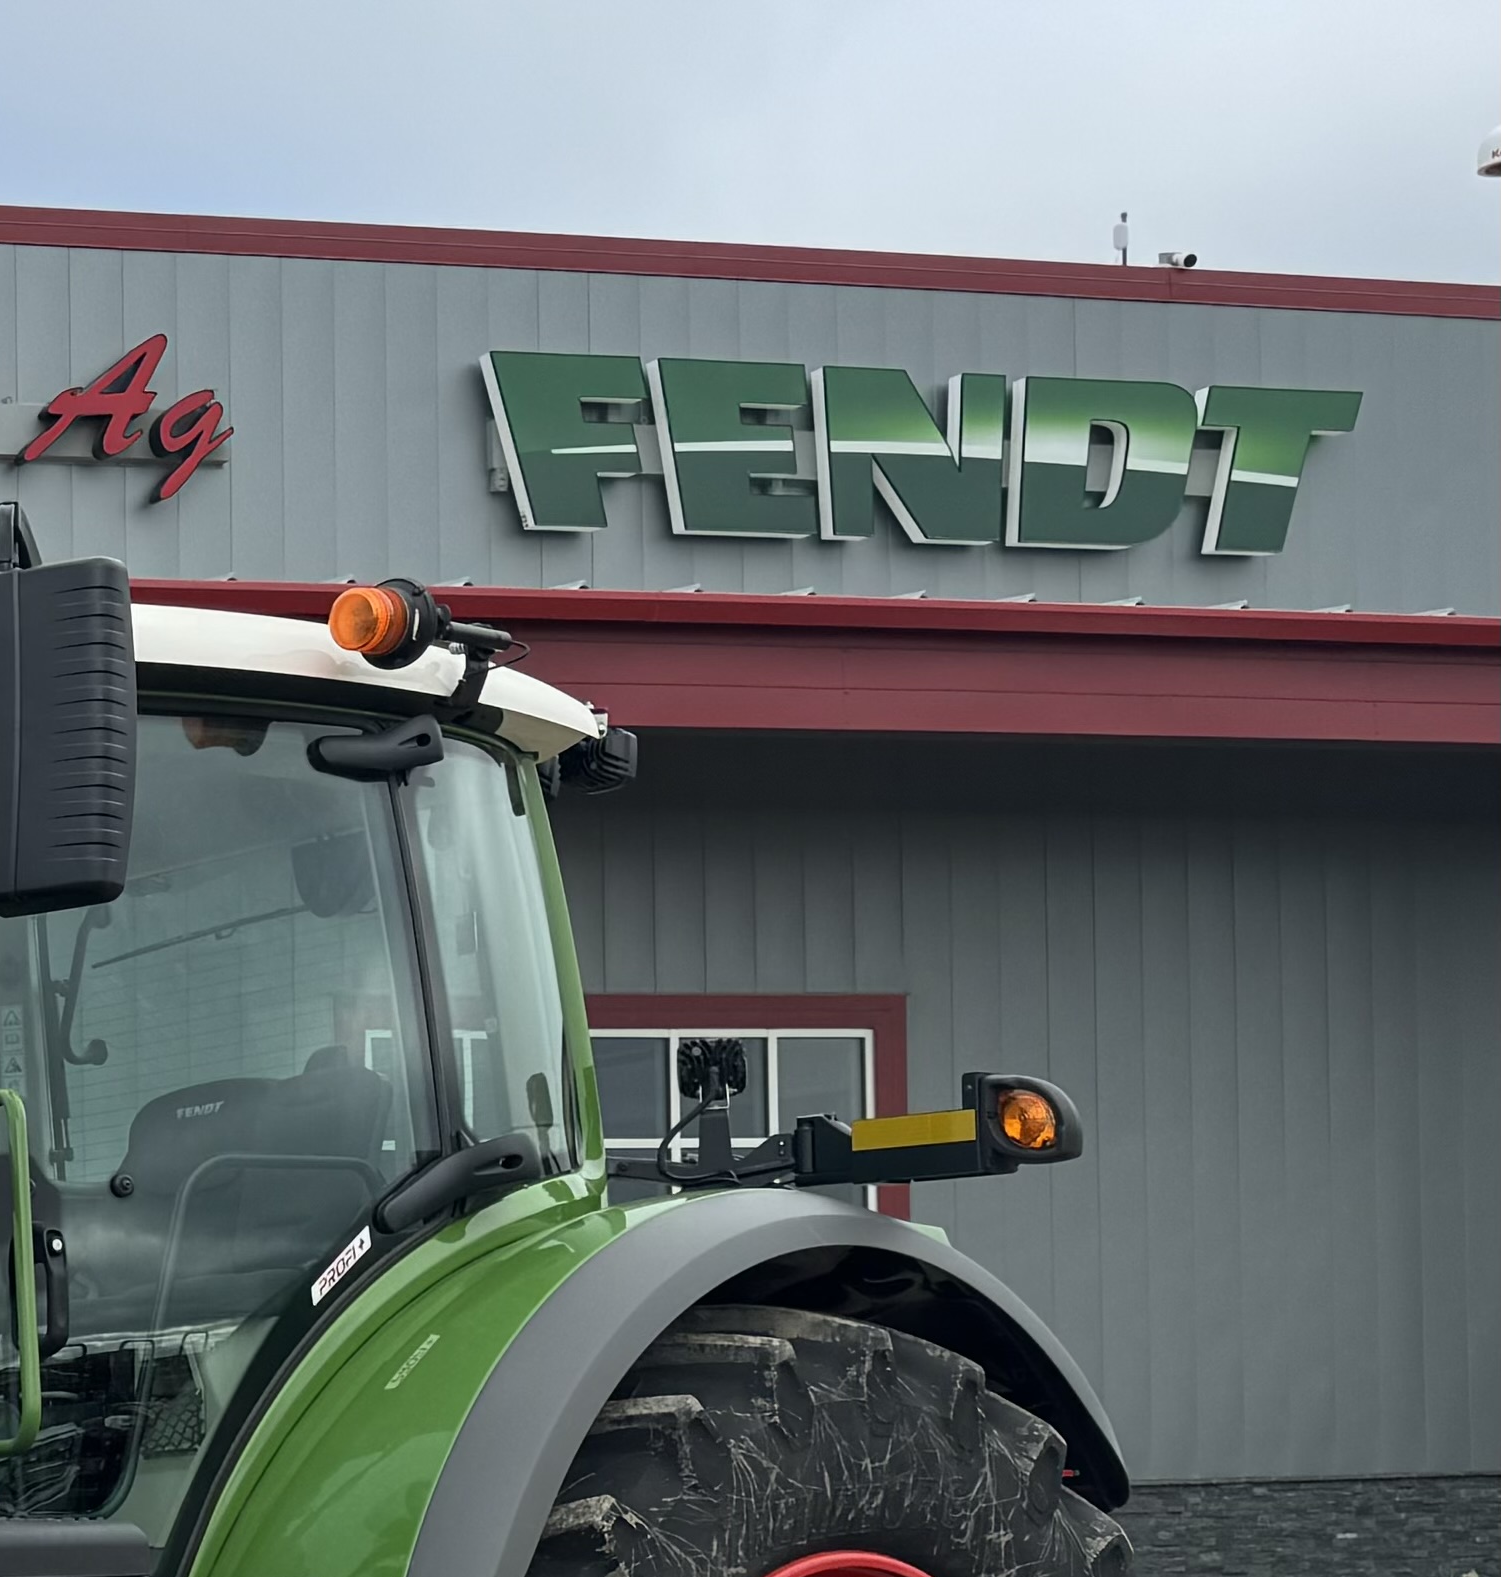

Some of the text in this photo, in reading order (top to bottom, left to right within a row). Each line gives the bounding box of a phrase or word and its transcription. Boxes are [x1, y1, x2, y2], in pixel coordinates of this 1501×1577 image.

[15, 332, 235, 504] Ag
[479, 350, 1364, 557] FENDT
[176, 1100, 225, 1119] FENDT
